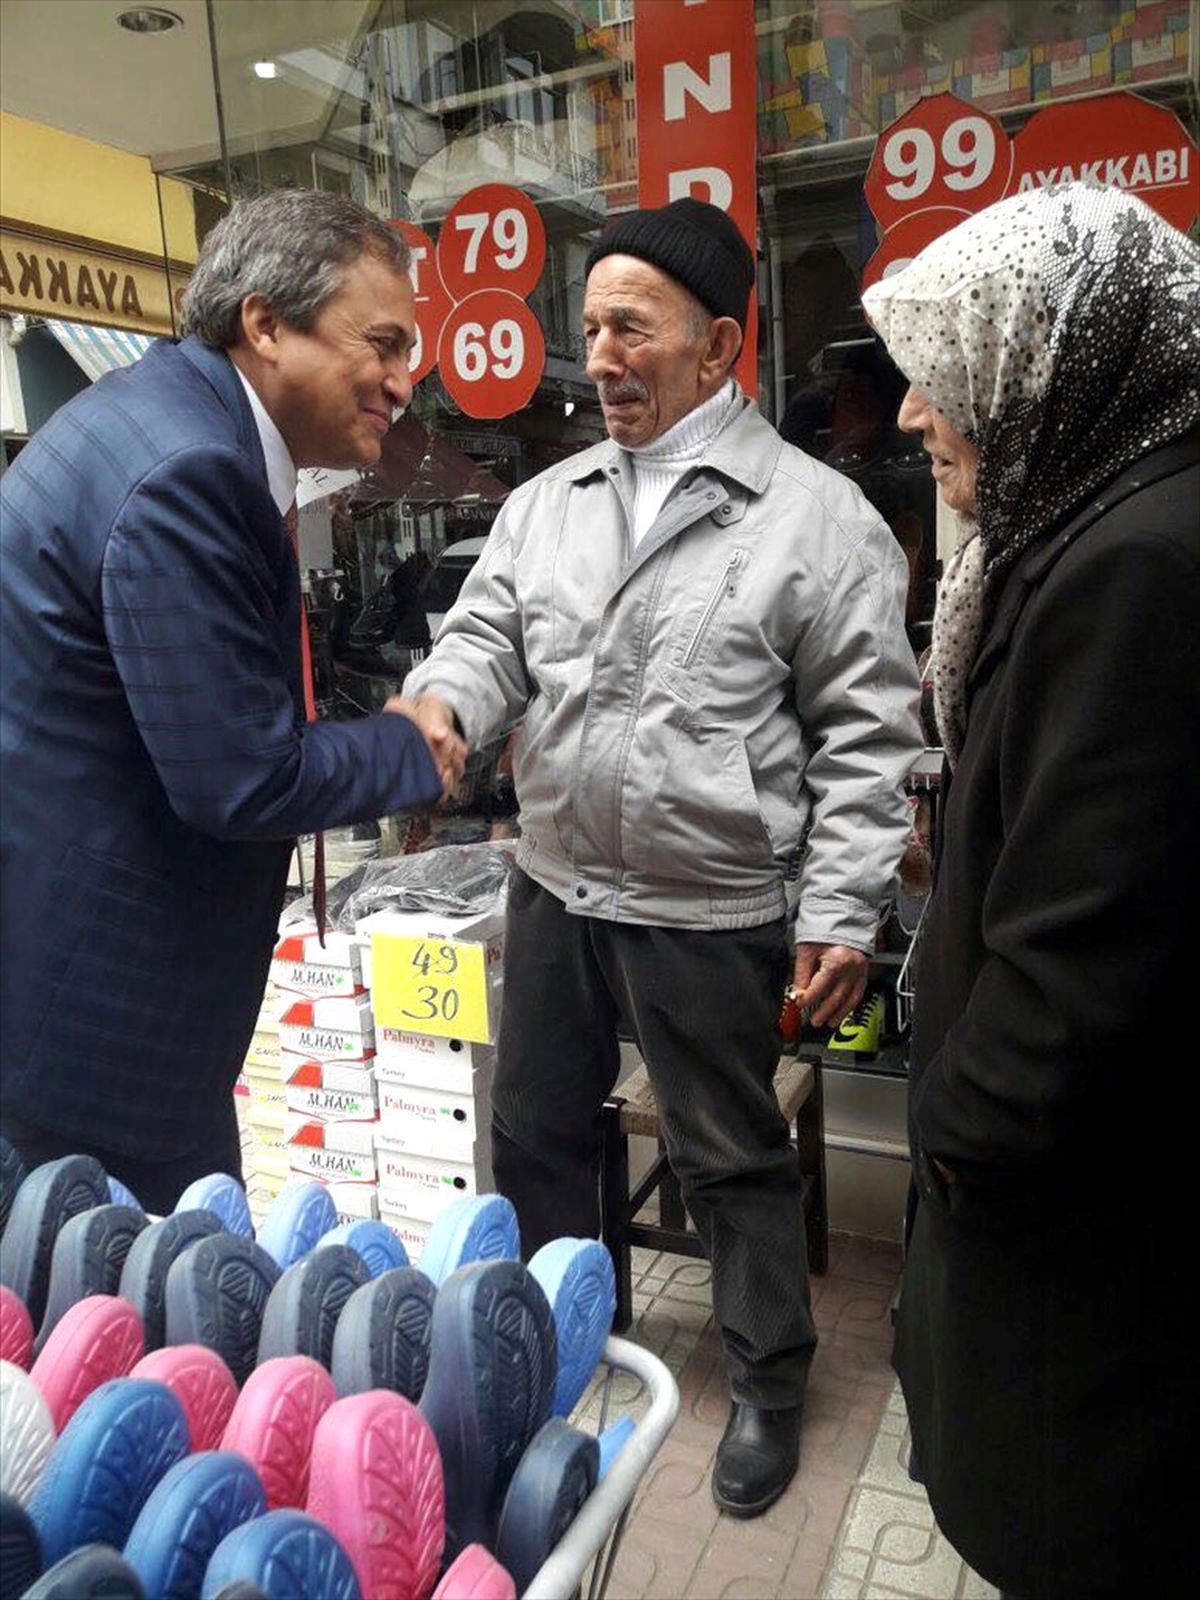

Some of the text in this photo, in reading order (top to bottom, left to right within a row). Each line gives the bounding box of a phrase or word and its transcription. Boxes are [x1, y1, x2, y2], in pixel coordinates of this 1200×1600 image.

[883, 117, 996, 200] 99
[1018, 147, 1189, 193] AYAKKABI
[455, 208, 528, 273] 79
[453, 319, 524, 381] 69
[412, 943, 458, 976] 49
[401, 985, 459, 1021] 30
[383, 1028, 436, 1049] Palmyra
[384, 1095, 437, 1117] Palmyra
[386, 1163, 440, 1184] Palmyra
